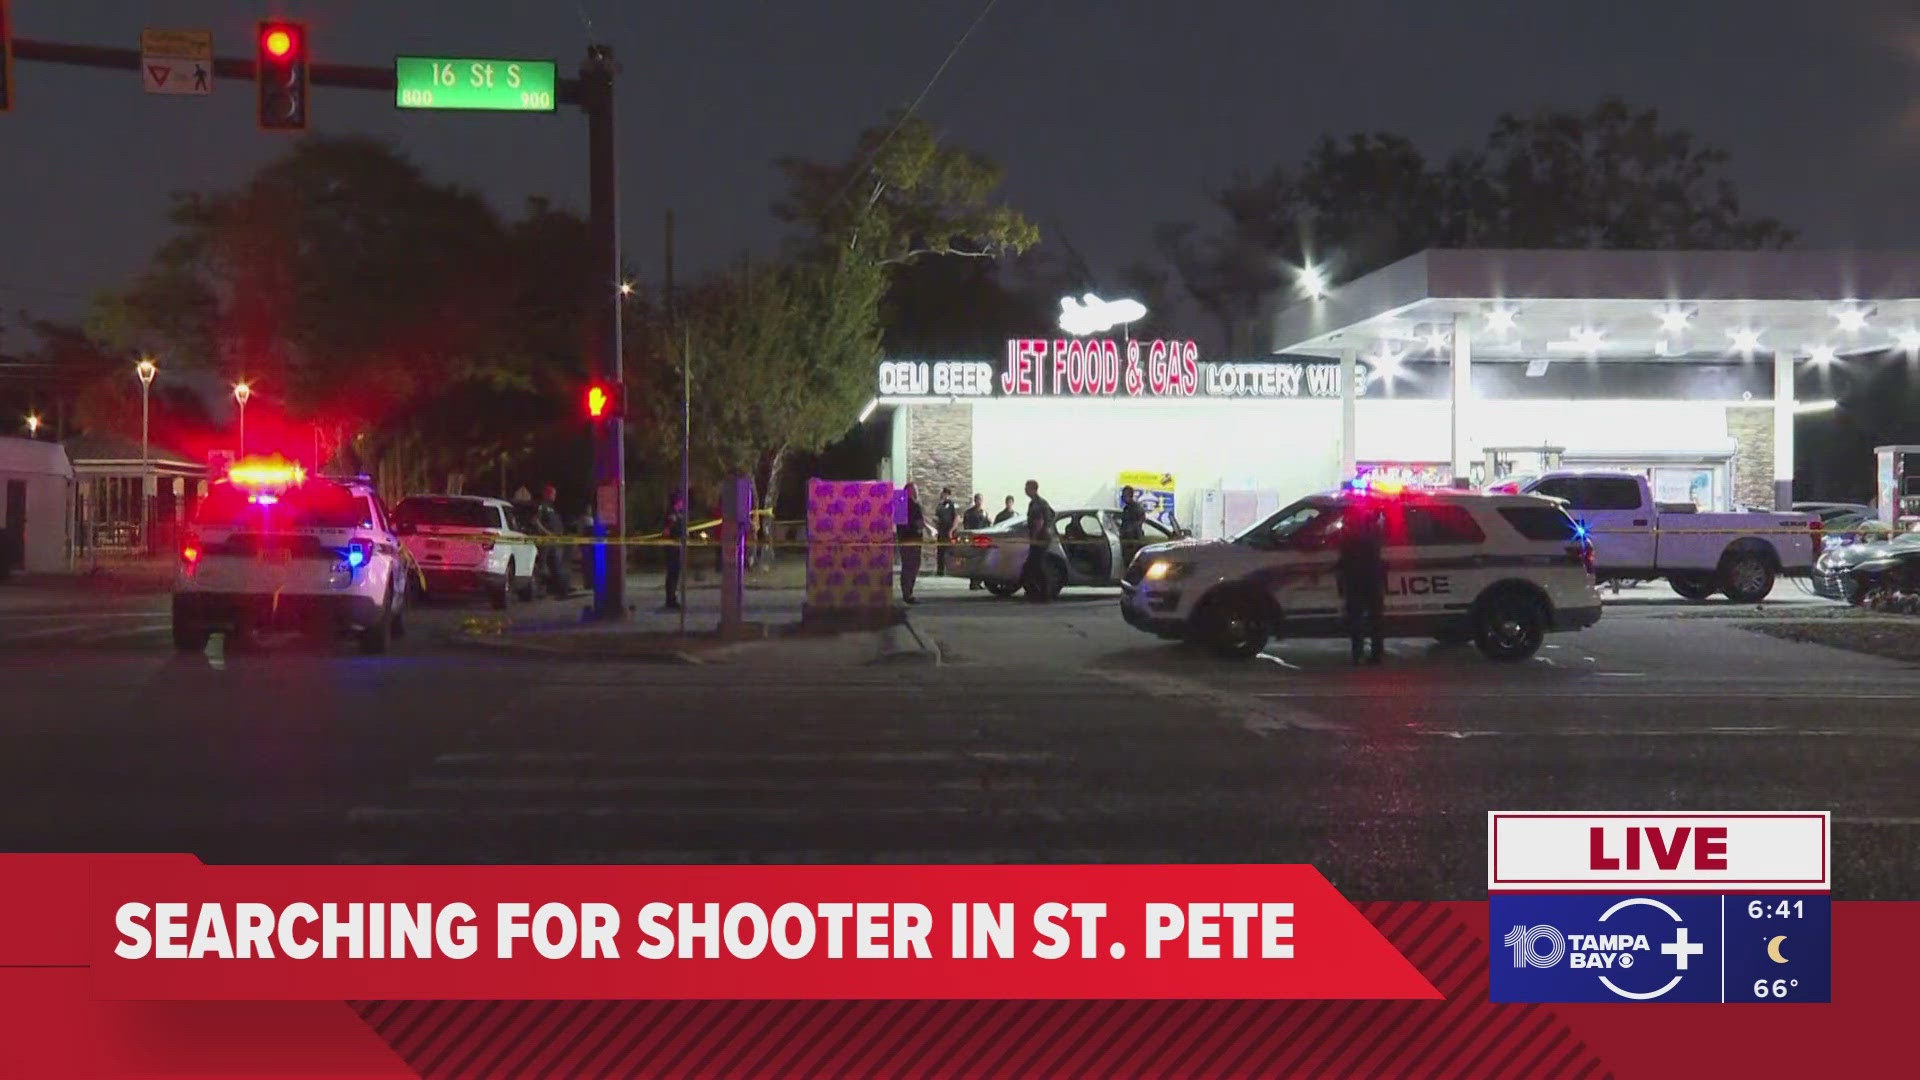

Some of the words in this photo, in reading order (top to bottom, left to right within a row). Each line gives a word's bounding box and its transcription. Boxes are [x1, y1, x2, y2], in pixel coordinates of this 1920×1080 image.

[432, 62, 456, 87] 16
[470, 63, 495, 88] St
[507, 63, 522, 89] S
[402, 89, 434, 106] 800
[521, 91, 551, 109] 900
[879, 361, 929, 395] DELI
[933, 361, 993, 395] BEER
[1002, 338, 1047, 396] JET
[1053, 338, 1119, 396] FOOD
[1125, 339, 1144, 396] &
[1149, 339, 1198, 396] GAS
[1206, 363, 1302, 396] LOTTERY
[1306, 364, 1367, 396] WIE
[1339, 574, 1452, 597] LICE
